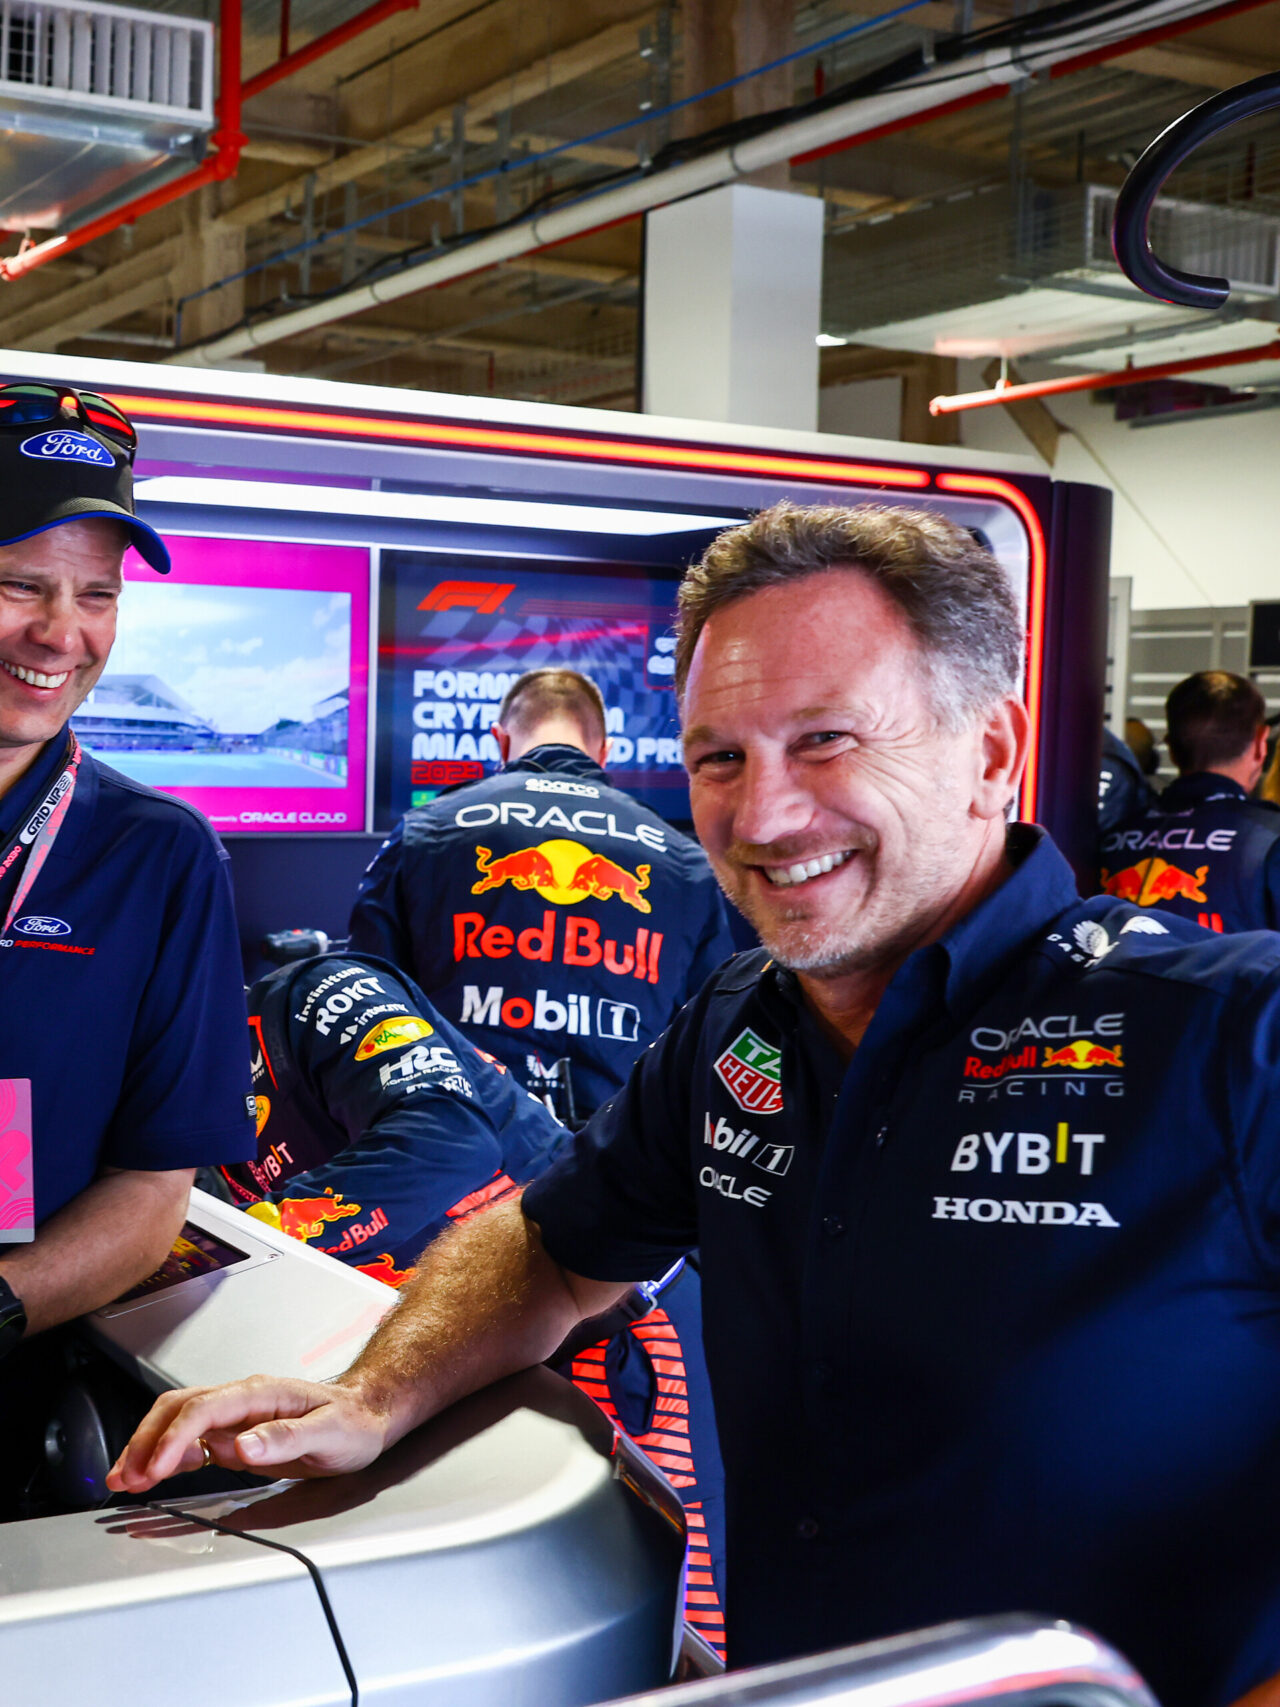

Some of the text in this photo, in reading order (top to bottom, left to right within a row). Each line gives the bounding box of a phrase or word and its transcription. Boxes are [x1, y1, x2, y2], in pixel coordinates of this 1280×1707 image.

[41, 430, 104, 462] Ford
[417, 580, 516, 614] F1
[413, 670, 521, 700] FORM
[412, 732, 501, 761] MIAM
[411, 761, 483, 785] 2023
[26, 806, 51, 836] GRID
[240, 811, 297, 823] ORACLE
[299, 812, 347, 823] CLOUD
[455, 802, 667, 852] ORACLE
[1102, 829, 1237, 851] ORACLE
[24, 918, 61, 933] Ford
[14, 940, 96, 955] PERFORMANCE
[453, 910, 663, 984] Red Bull
[294, 966, 367, 1023] infinitum
[315, 977, 386, 1036] ROKT
[459, 984, 590, 1036] Mobil
[379, 1045, 458, 1087] HRC
[745, 1037, 781, 1076] TA
[964, 1054, 1009, 1079] Red
[722, 1058, 783, 1110] HEUE
[950, 1122, 1106, 1176] BYBIT
[349, 1207, 390, 1245] Bull
[931, 1196, 1120, 1228] HONDA
